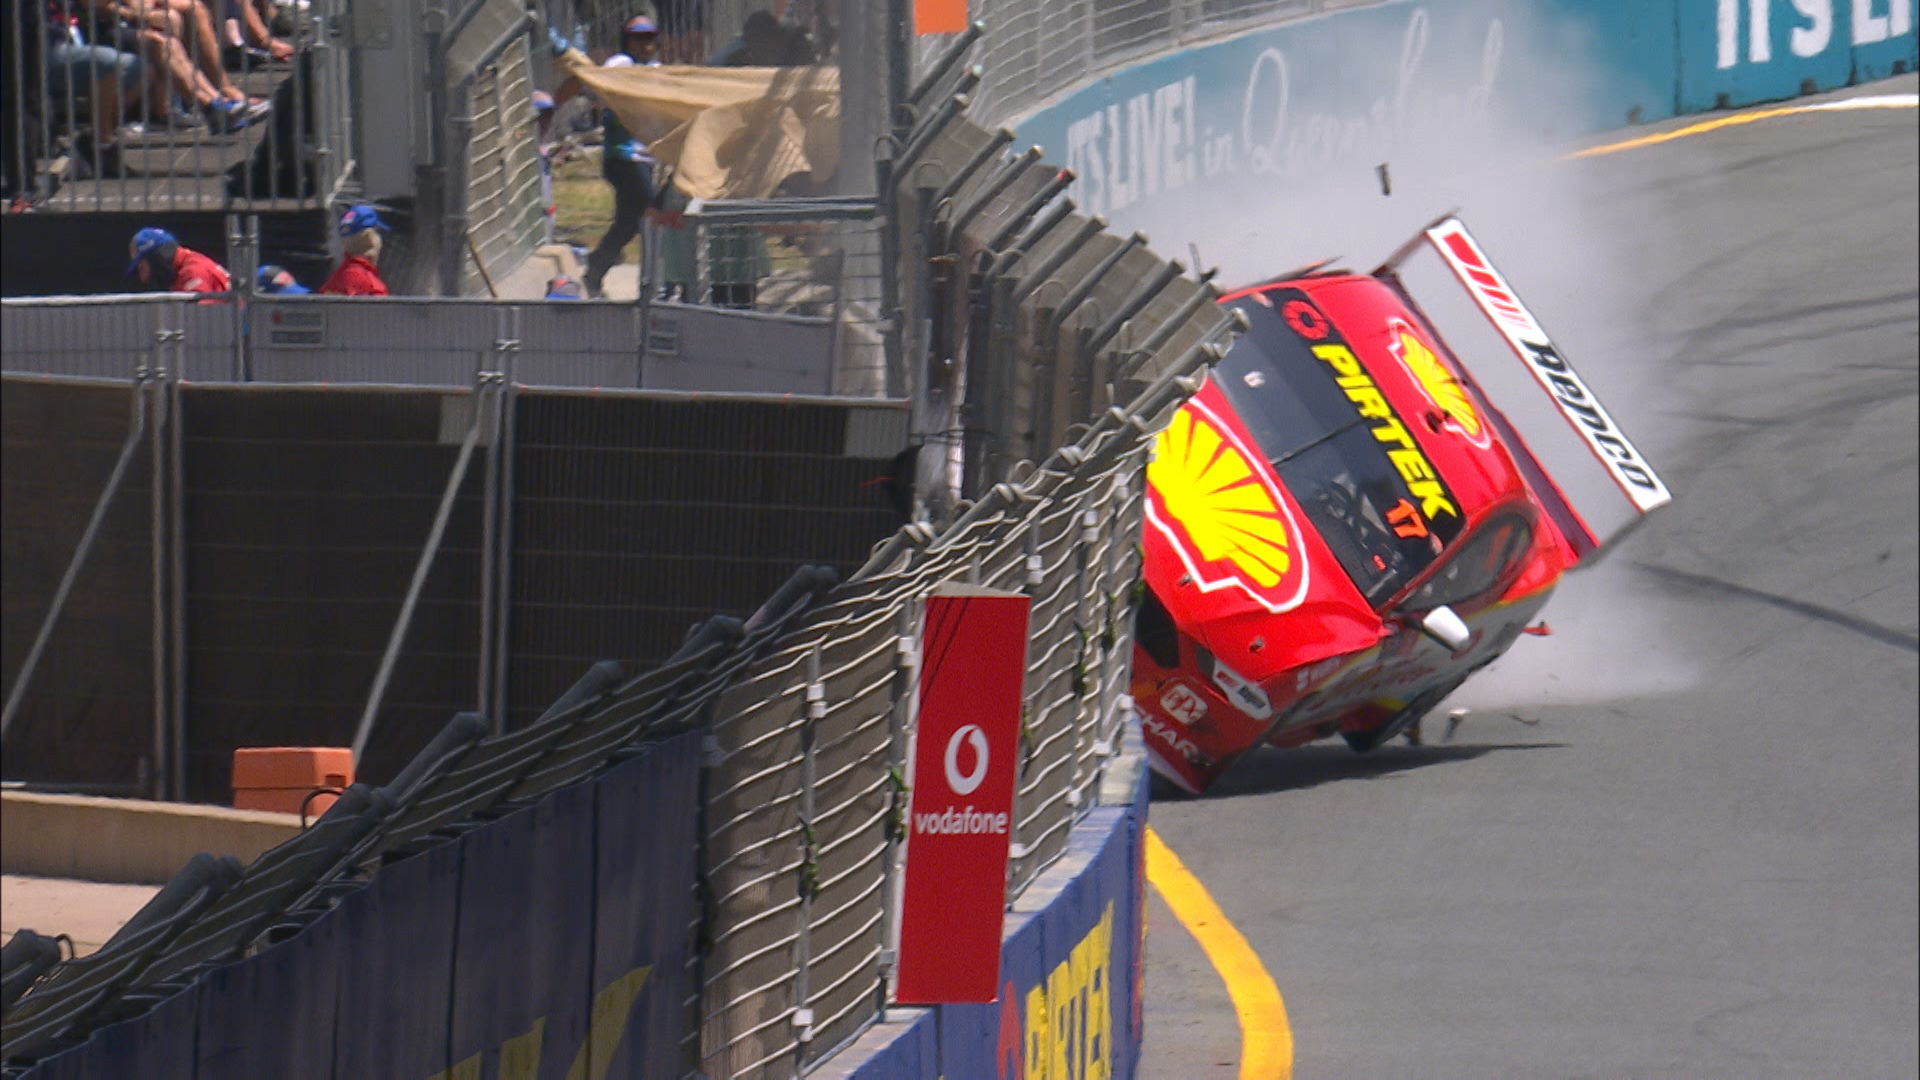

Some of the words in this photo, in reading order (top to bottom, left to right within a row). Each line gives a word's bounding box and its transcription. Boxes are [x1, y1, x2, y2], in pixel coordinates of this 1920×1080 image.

[1716, 0, 1833, 70] ITS
[1106, 75, 1196, 210] LIVE!
[1204, 127, 1236, 177] in
[1242, 7, 1504, 177] Queensld
[1310, 343, 1458, 521] PIRTEK
[1385, 497, 1429, 539] 17
[914, 805, 1009, 836] vodafone
